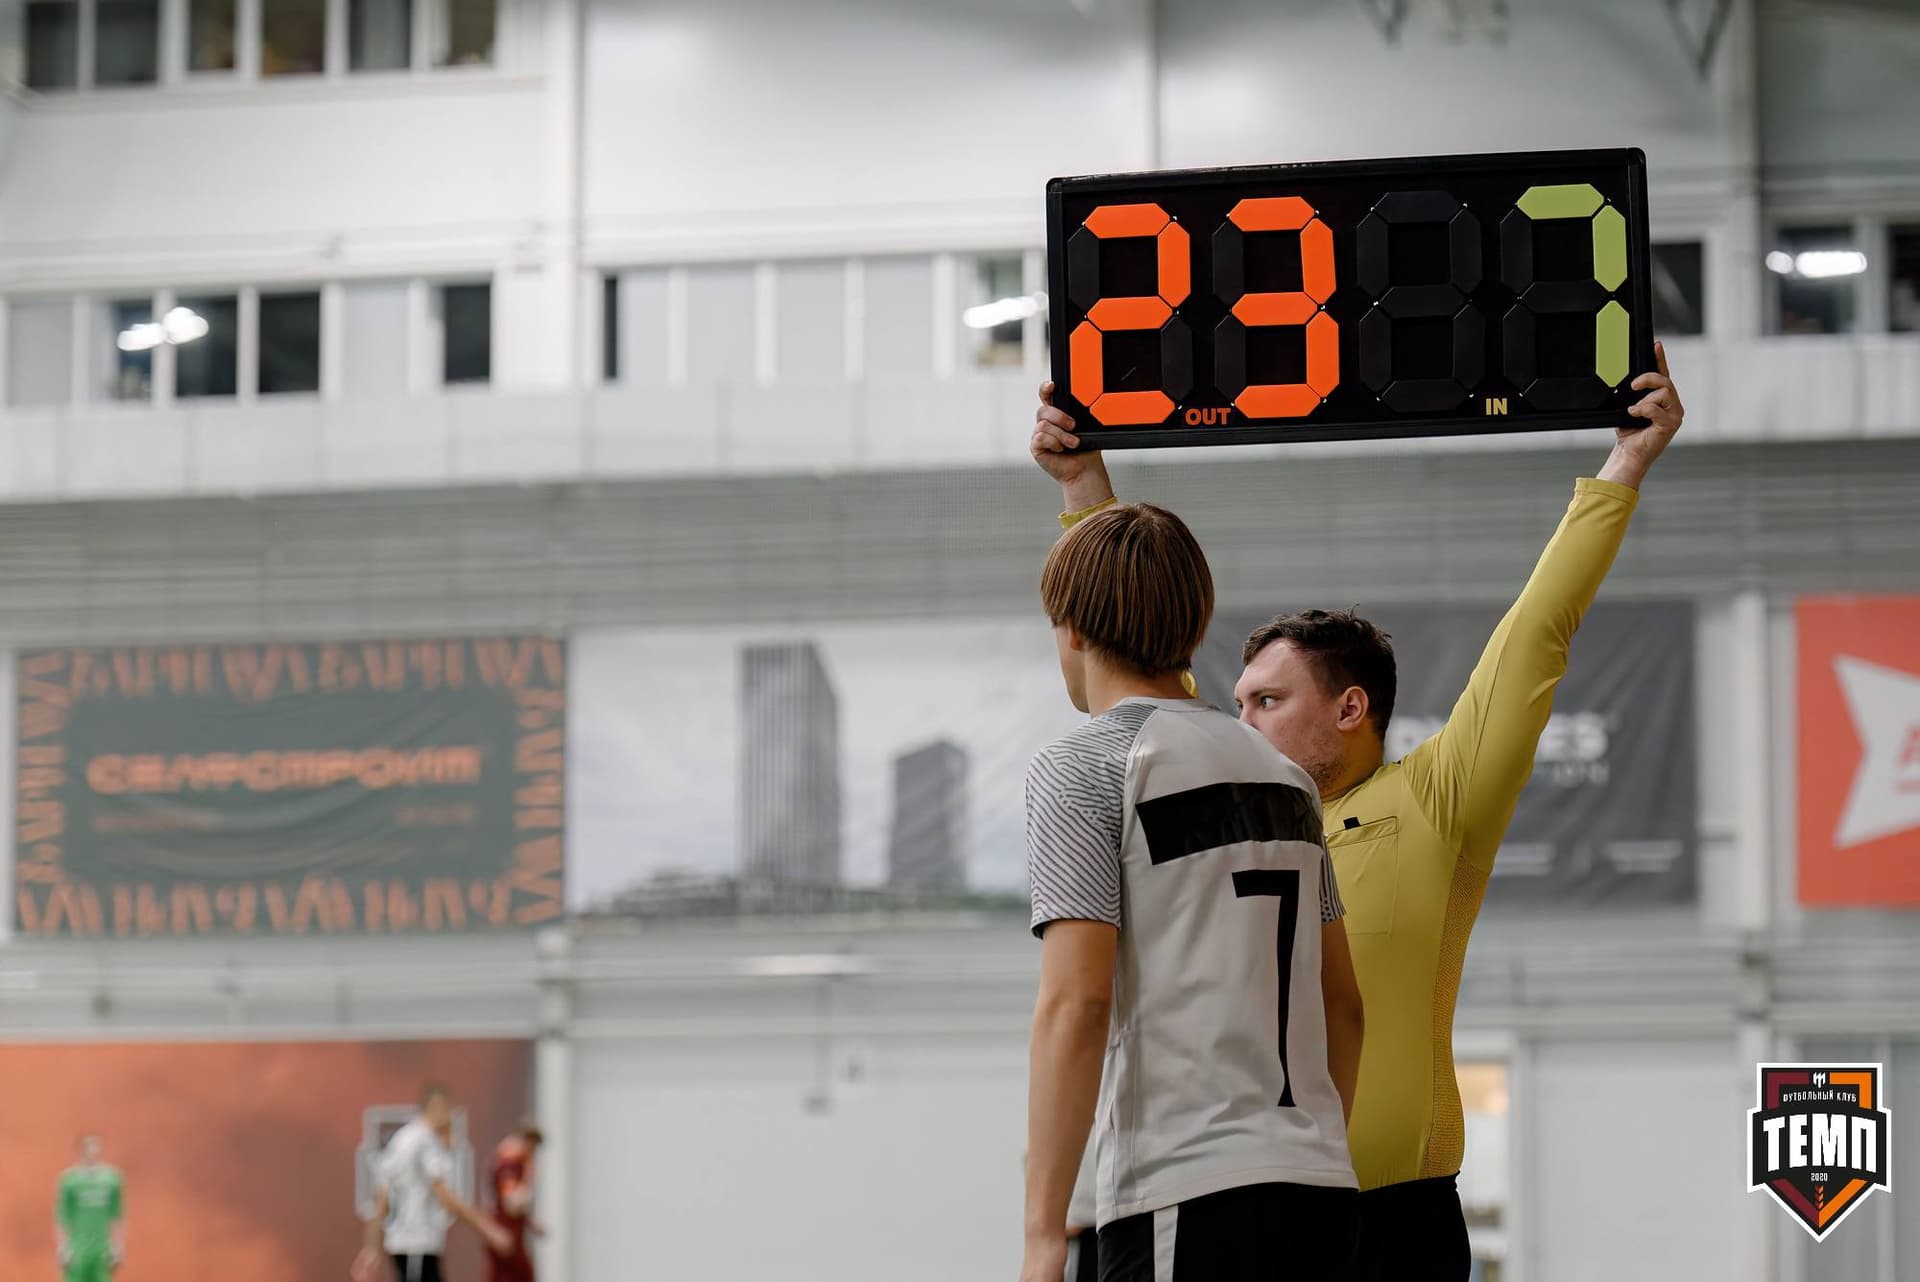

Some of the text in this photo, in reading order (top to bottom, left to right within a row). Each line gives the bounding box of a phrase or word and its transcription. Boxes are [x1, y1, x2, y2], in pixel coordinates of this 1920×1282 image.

[1070, 183, 1631, 426] 23 7
[1185, 407, 1232, 426] OUT
[1485, 397, 1508, 416] IN
[1231, 868, 1300, 1107] 7
